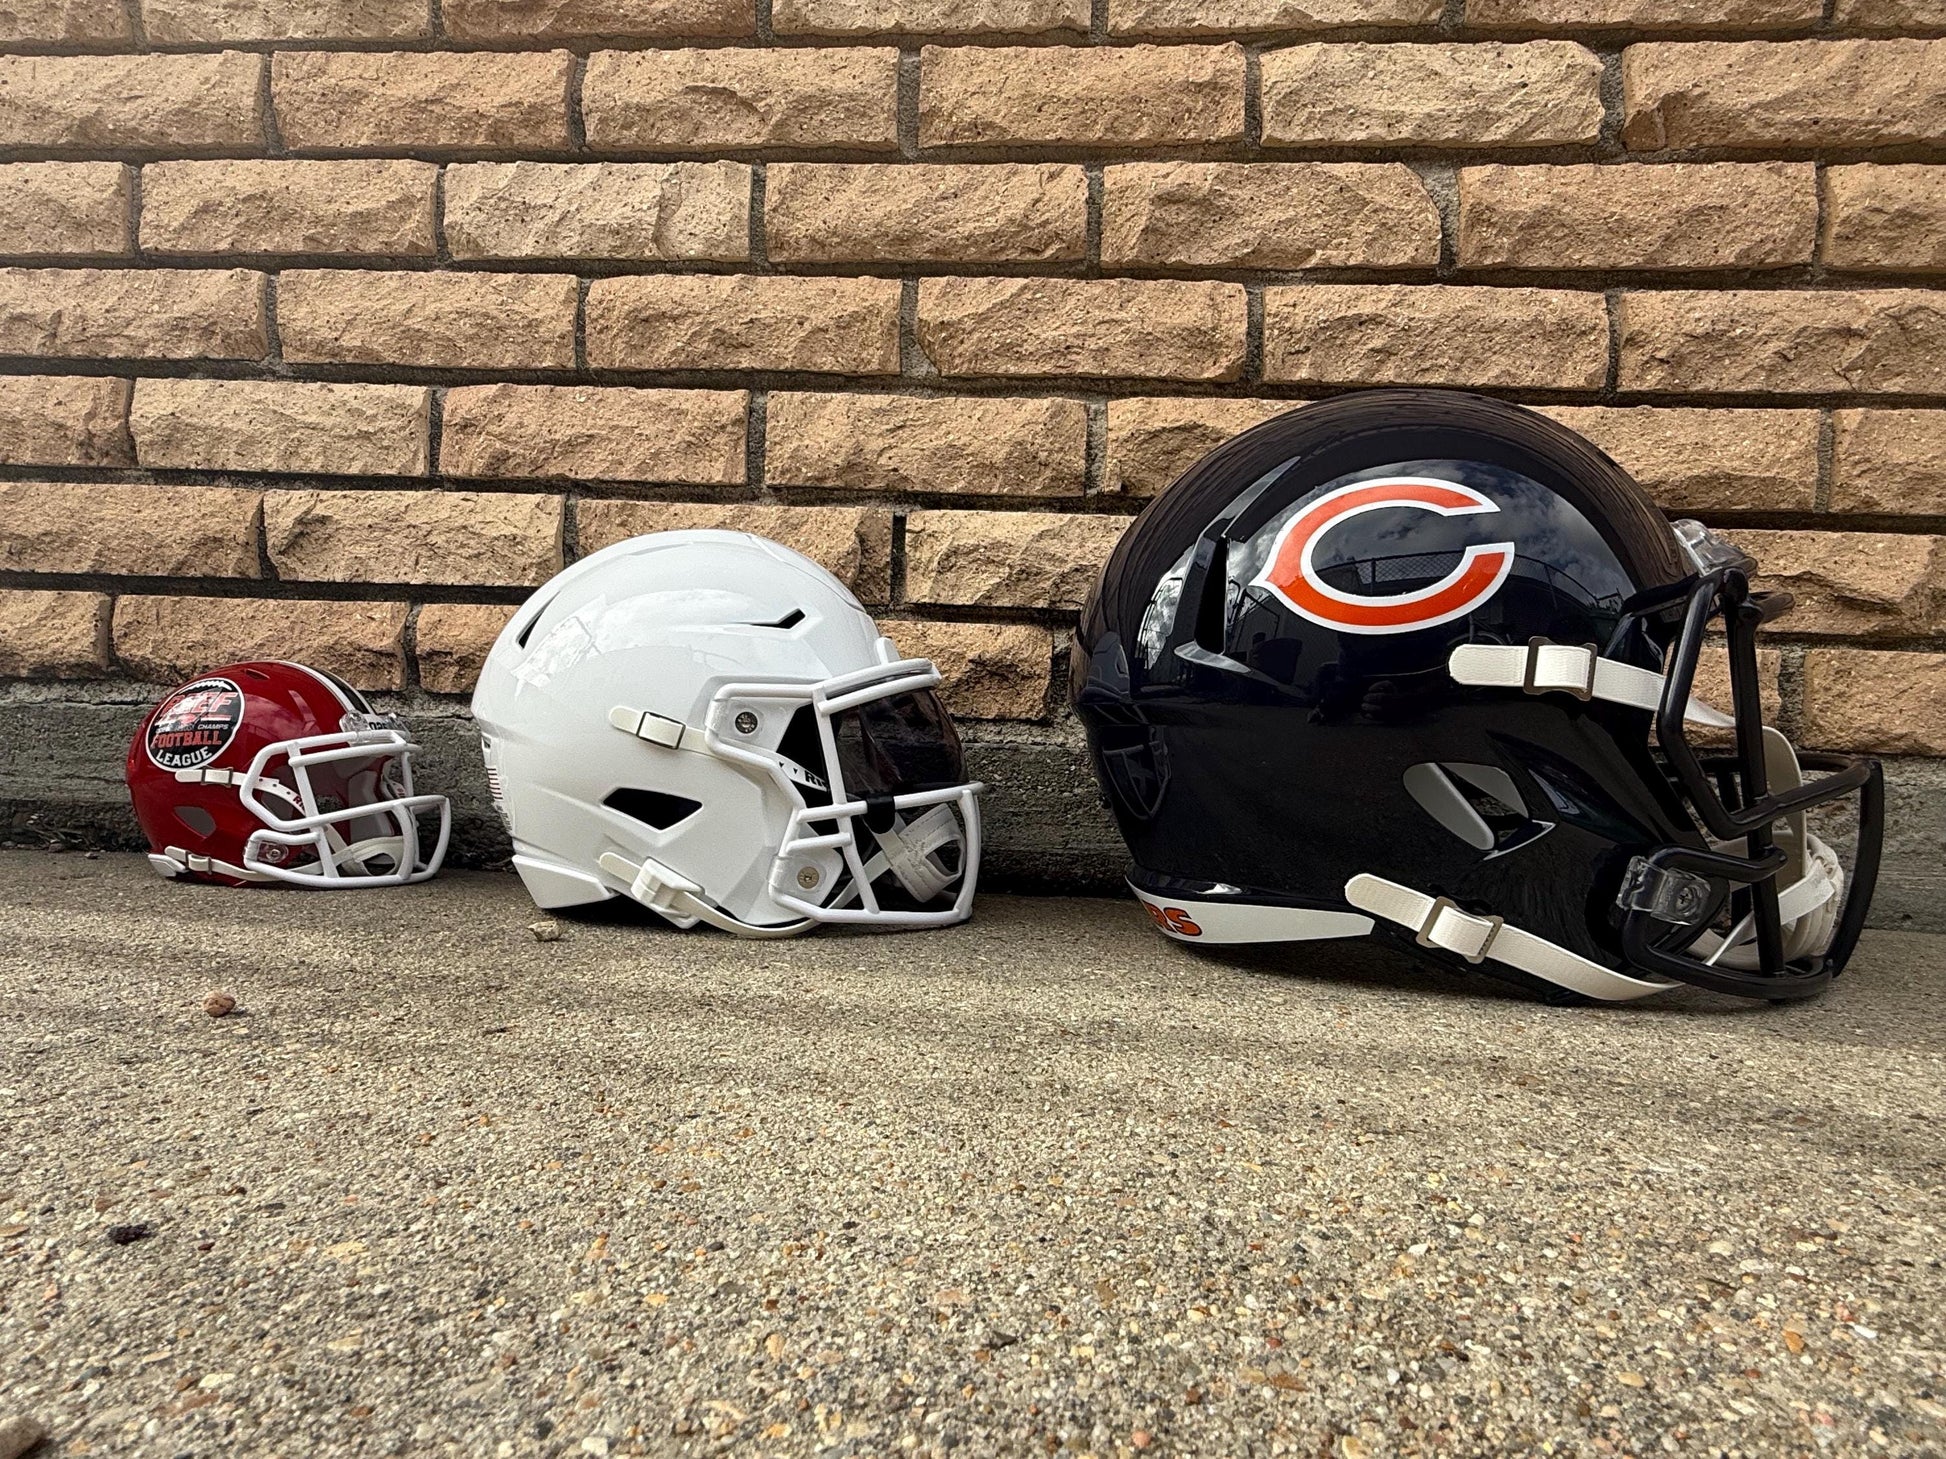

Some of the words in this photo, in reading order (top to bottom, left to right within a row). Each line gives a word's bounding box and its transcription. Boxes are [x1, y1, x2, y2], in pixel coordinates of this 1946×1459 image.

[1247, 476, 1515, 634] C
[150, 730, 222, 749] FOOTBALL
[156, 746, 213, 767] LEAGUE
